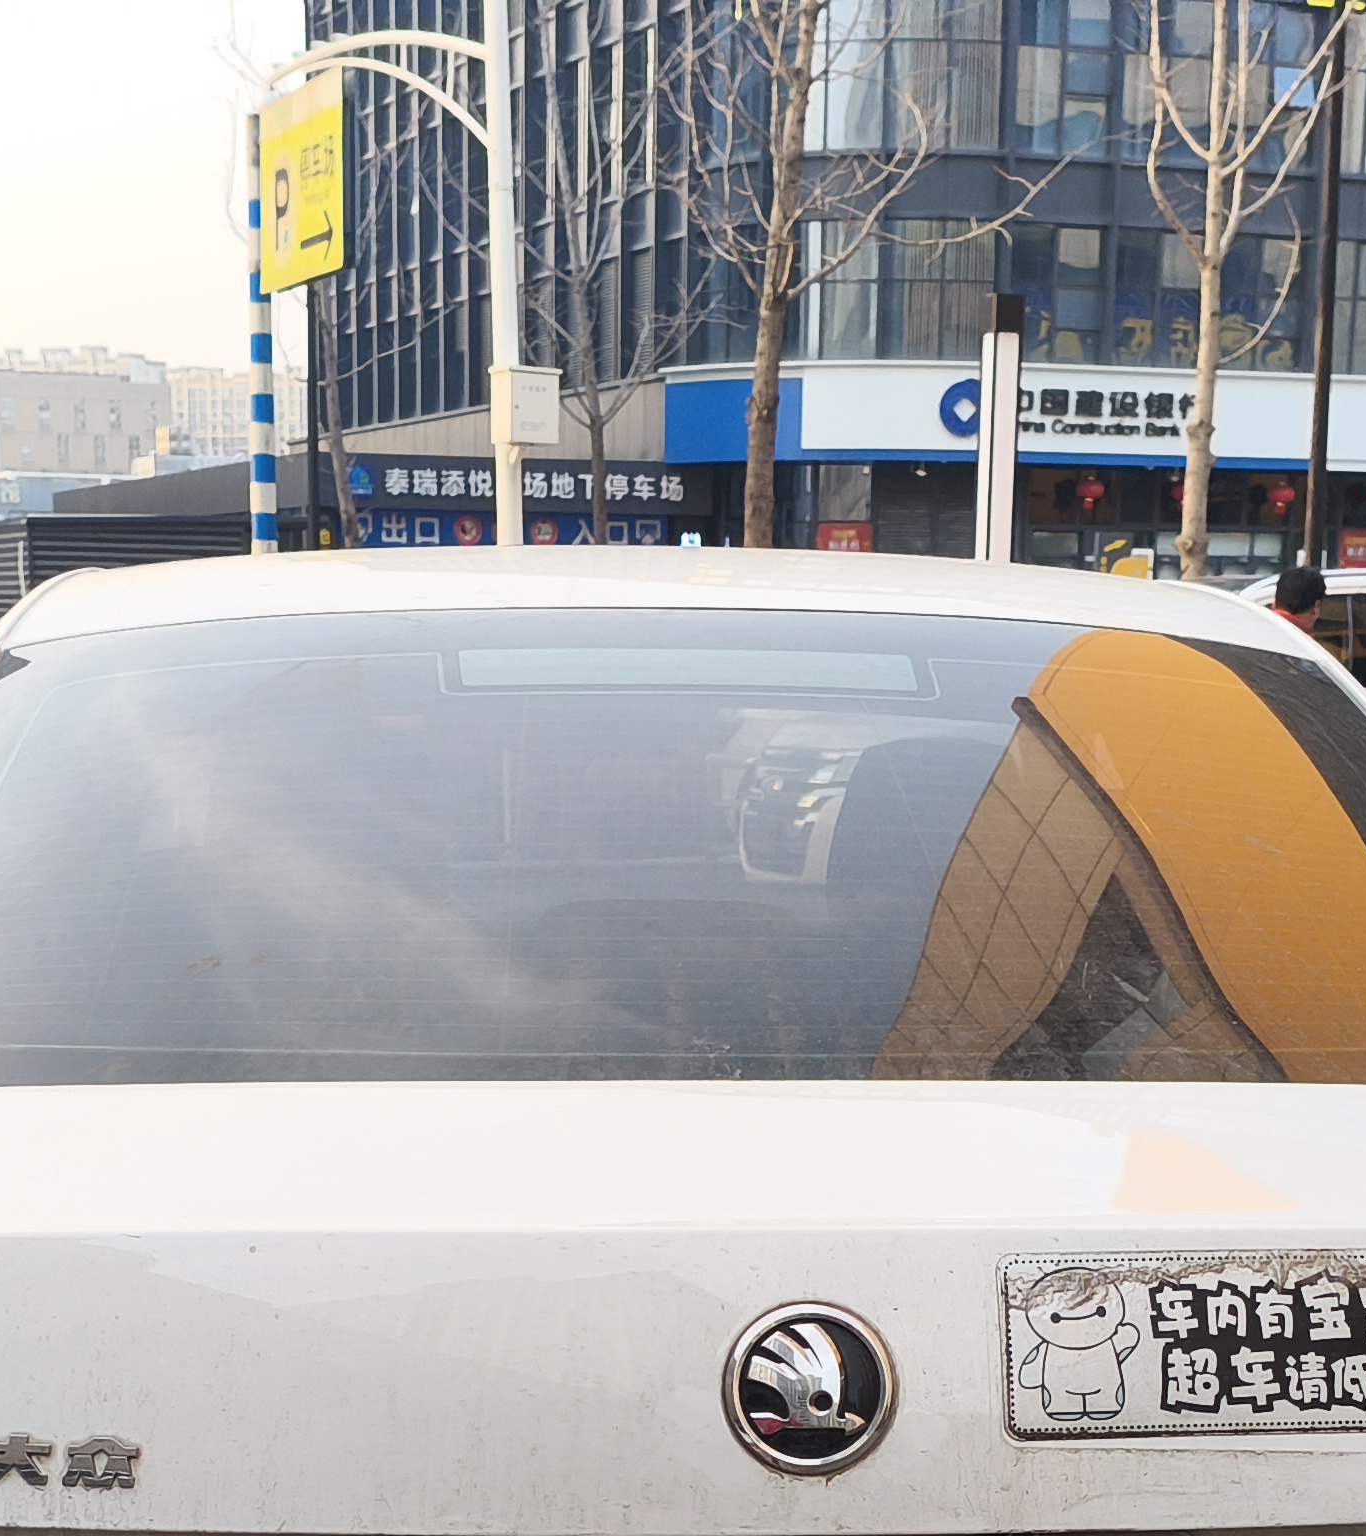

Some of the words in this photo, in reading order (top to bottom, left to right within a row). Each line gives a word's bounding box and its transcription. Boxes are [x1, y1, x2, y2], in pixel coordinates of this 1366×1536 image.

[1145, 422, 1180, 437] Bank
[384, 467, 684, 502] 泰瑞添悦场地下停车场
[381, 512, 440, 544] 出口
